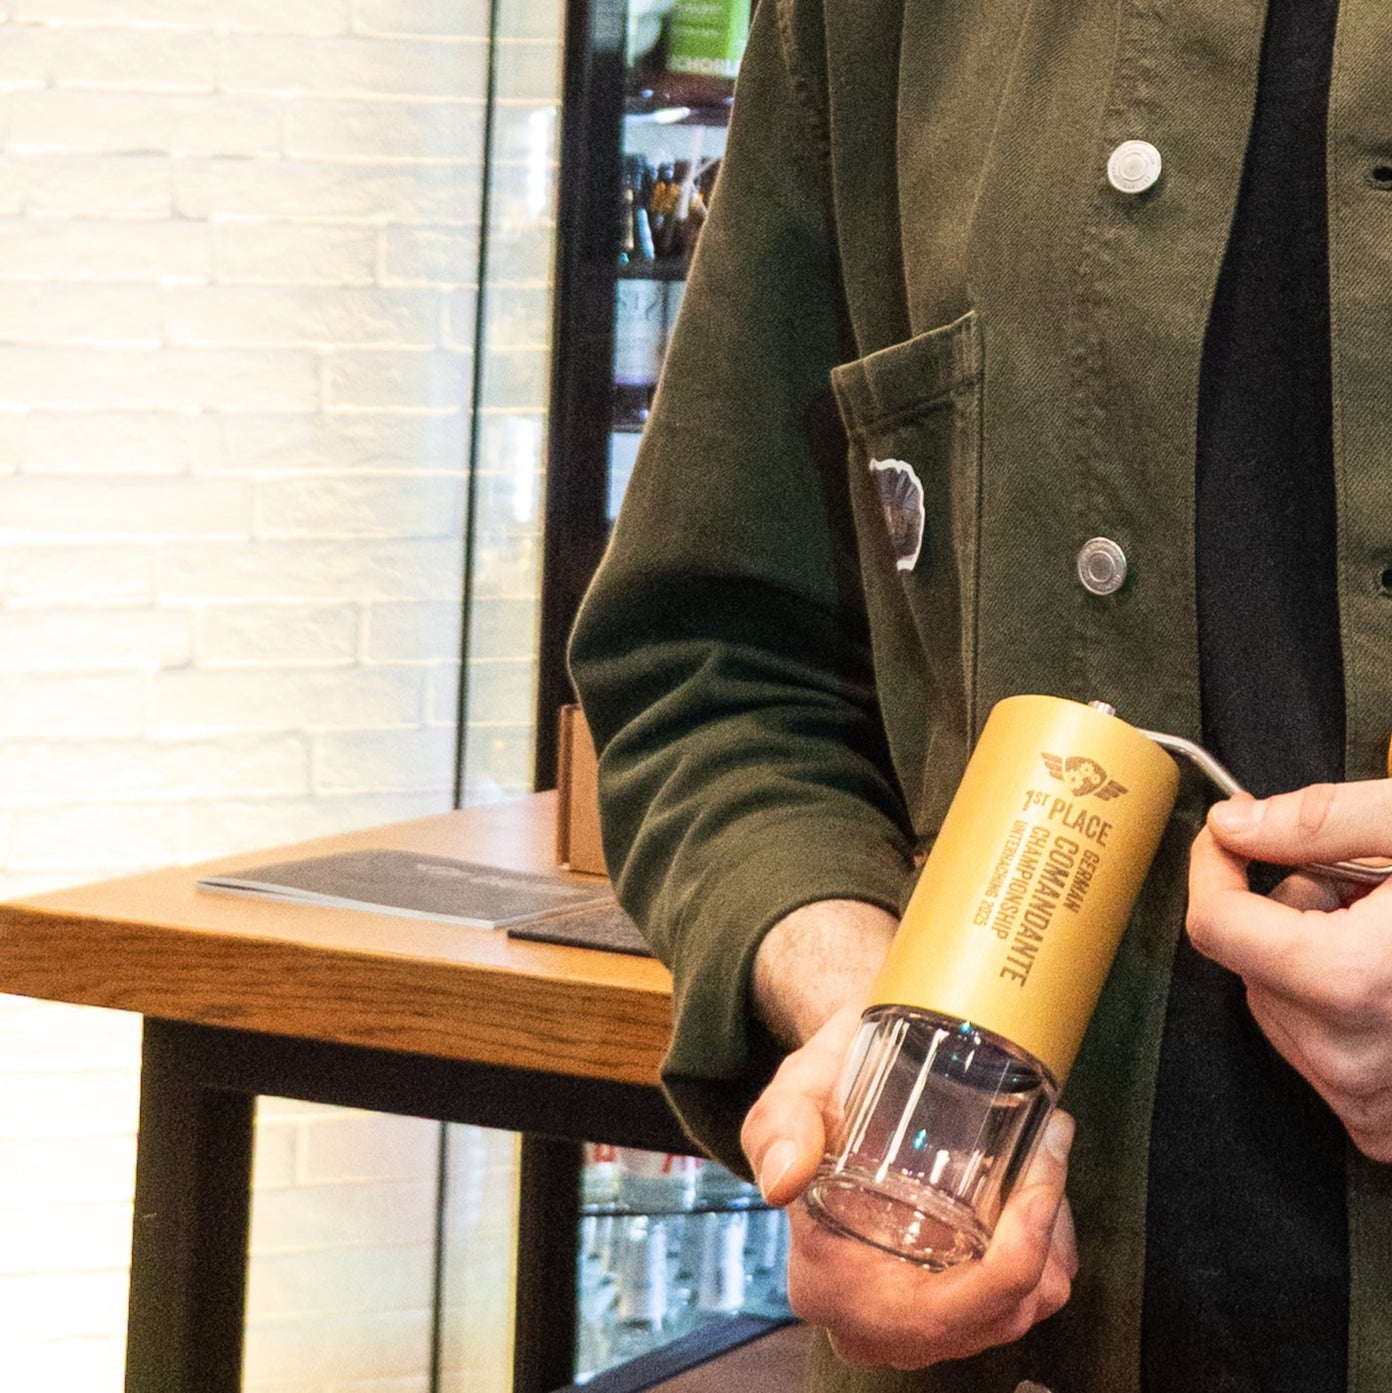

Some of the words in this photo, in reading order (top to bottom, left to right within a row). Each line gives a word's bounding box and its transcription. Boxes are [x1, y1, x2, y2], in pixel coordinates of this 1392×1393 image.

[1022, 789, 1051, 812] 1ST
[1048, 797, 1113, 847] PLACE
[984, 819, 1028, 899] UNTERHACHING
[991, 825, 1051, 940] CHAMPIONSHIP
[1063, 849, 1101, 913] GERMAN
[973, 899, 995, 927] 2025
[1000, 835, 1079, 987] COMANDANTE
